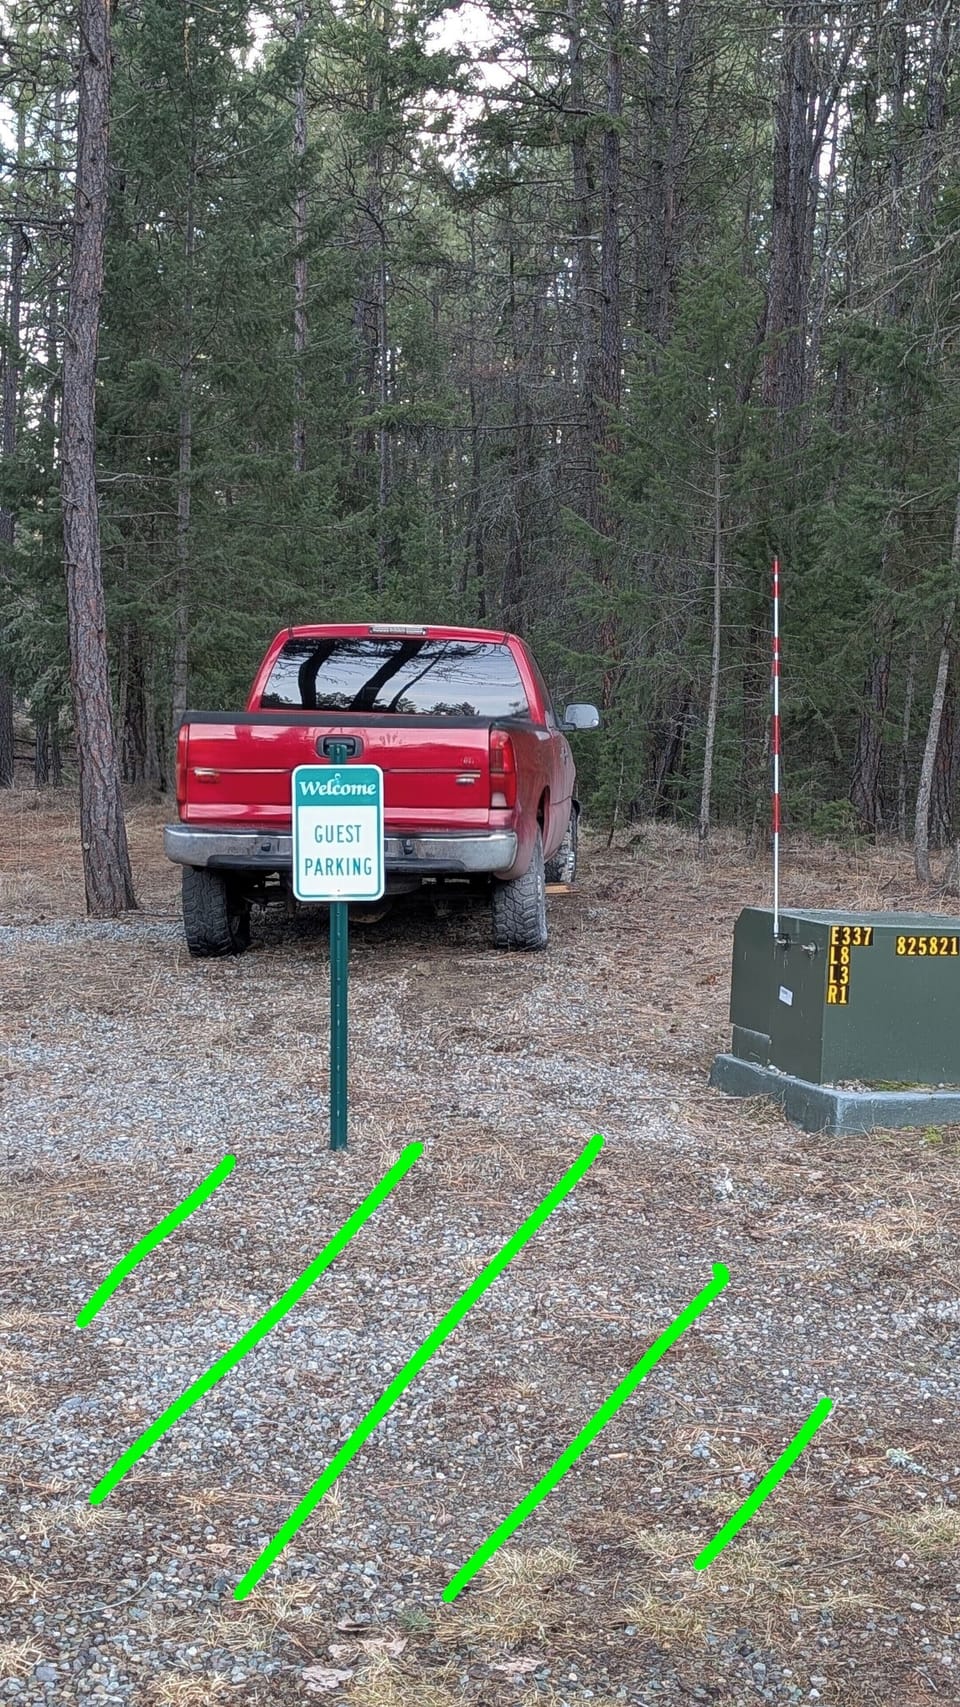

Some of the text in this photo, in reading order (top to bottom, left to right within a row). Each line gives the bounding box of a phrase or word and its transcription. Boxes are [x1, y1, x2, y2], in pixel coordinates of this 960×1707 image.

[300, 778, 376, 795] Welcome
[314, 824, 362, 843] GUEST
[304, 857, 372, 876] PARKING
[831, 926, 872, 945] E337
[897, 936, 958, 955] 825821
[830, 946, 849, 965] L8
[829, 966, 848, 984] L3
[827, 985, 847, 1004] R1
